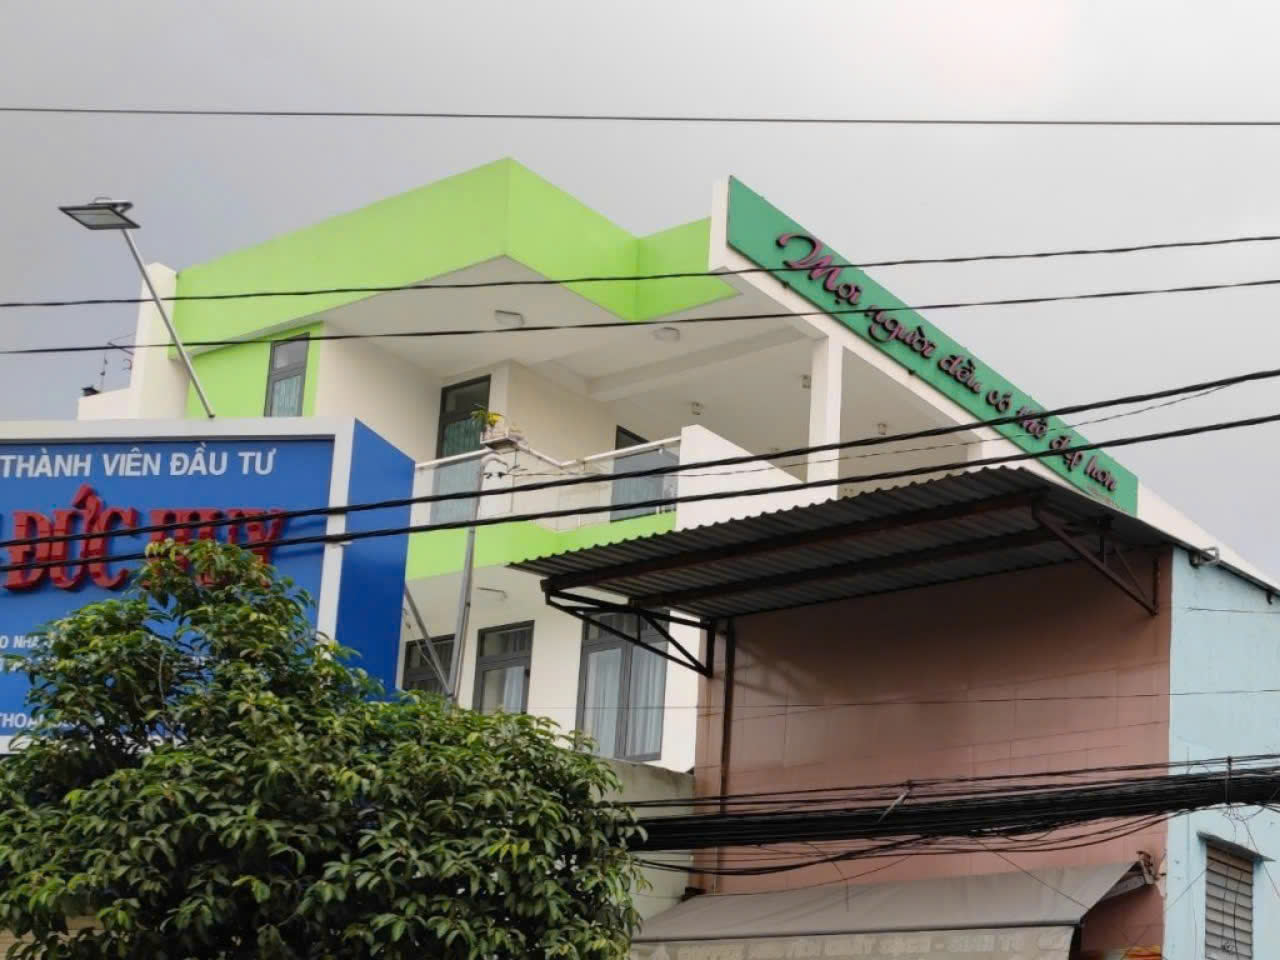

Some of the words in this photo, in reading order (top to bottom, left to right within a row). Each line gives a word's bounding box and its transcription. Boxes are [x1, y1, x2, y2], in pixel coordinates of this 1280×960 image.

[0, 446, 92, 478] THÀNH
[103, 447, 162, 477] VIÊN
[169, 442, 229, 477] ĐẦU
[238, 448, 277, 476] TƯ
[4, 484, 138, 592] ĐỨC
